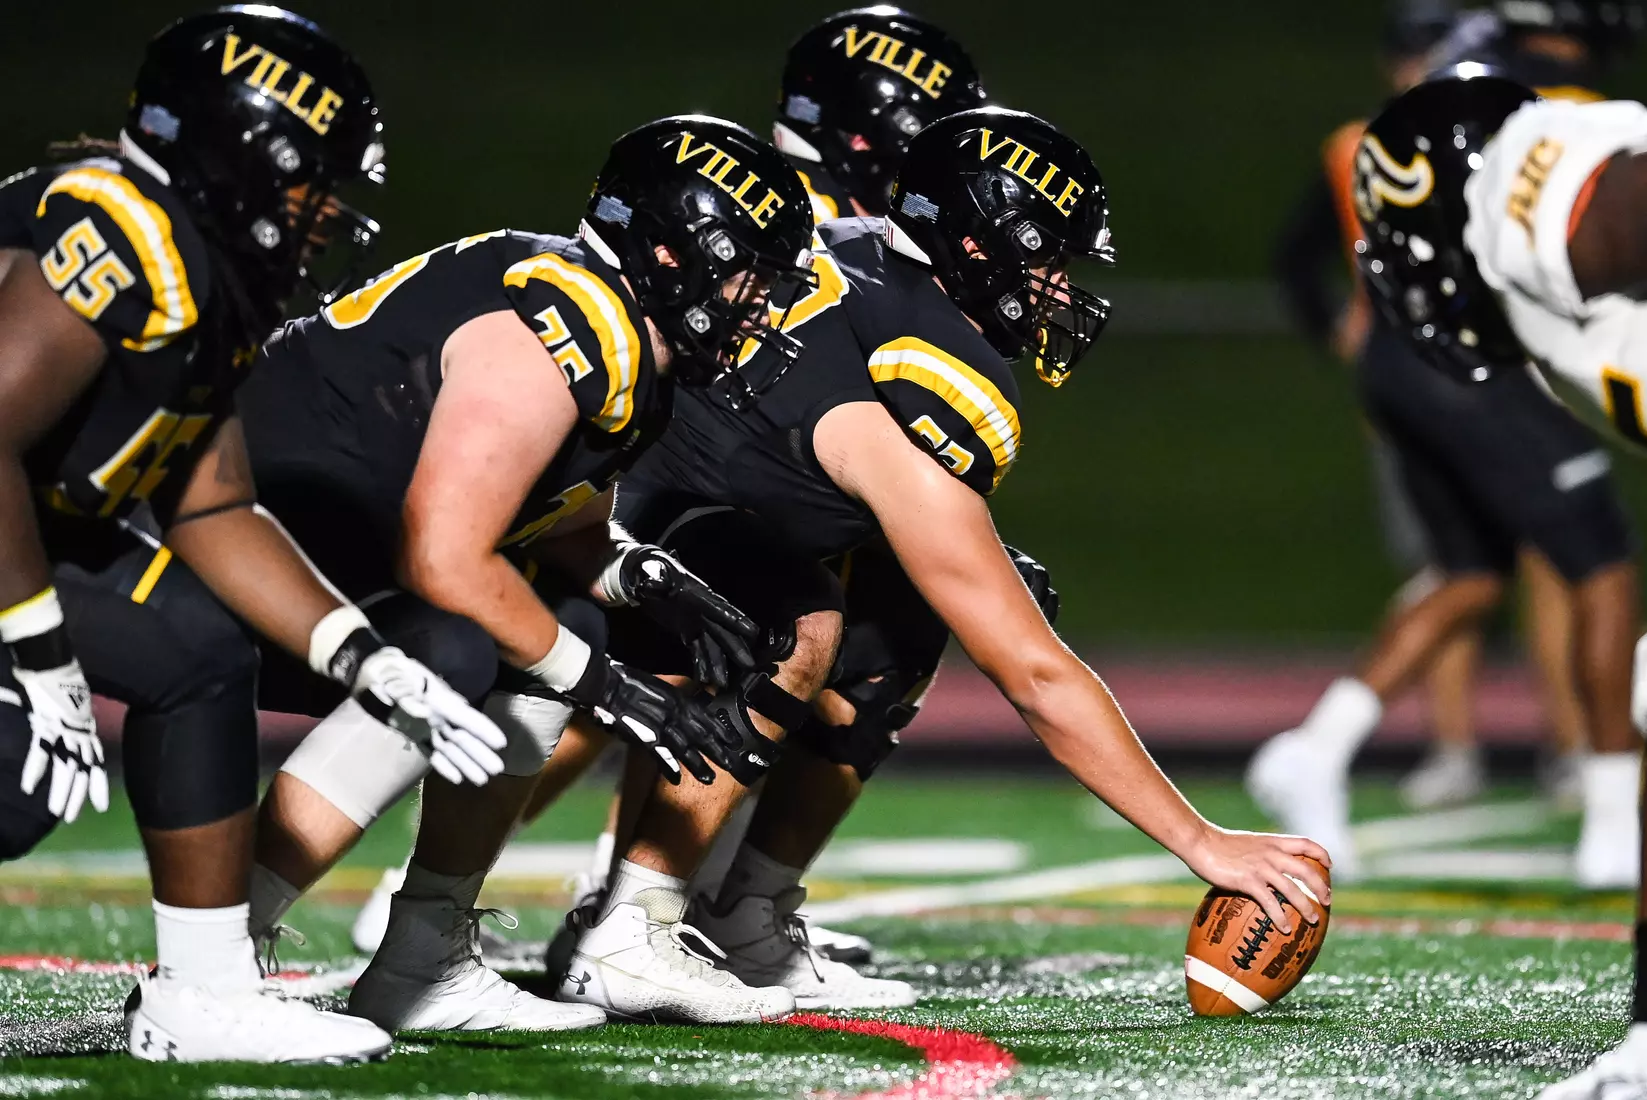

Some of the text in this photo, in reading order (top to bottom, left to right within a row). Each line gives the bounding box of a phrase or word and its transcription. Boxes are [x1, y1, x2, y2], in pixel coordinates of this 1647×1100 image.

[219, 33, 344, 136] VILLE
[843, 25, 953, 99] VILLE
[674, 131, 785, 230] VILLE
[977, 127, 1086, 217] VILLE
[40, 217, 135, 320] 55
[1211, 897, 1247, 945] ilson
